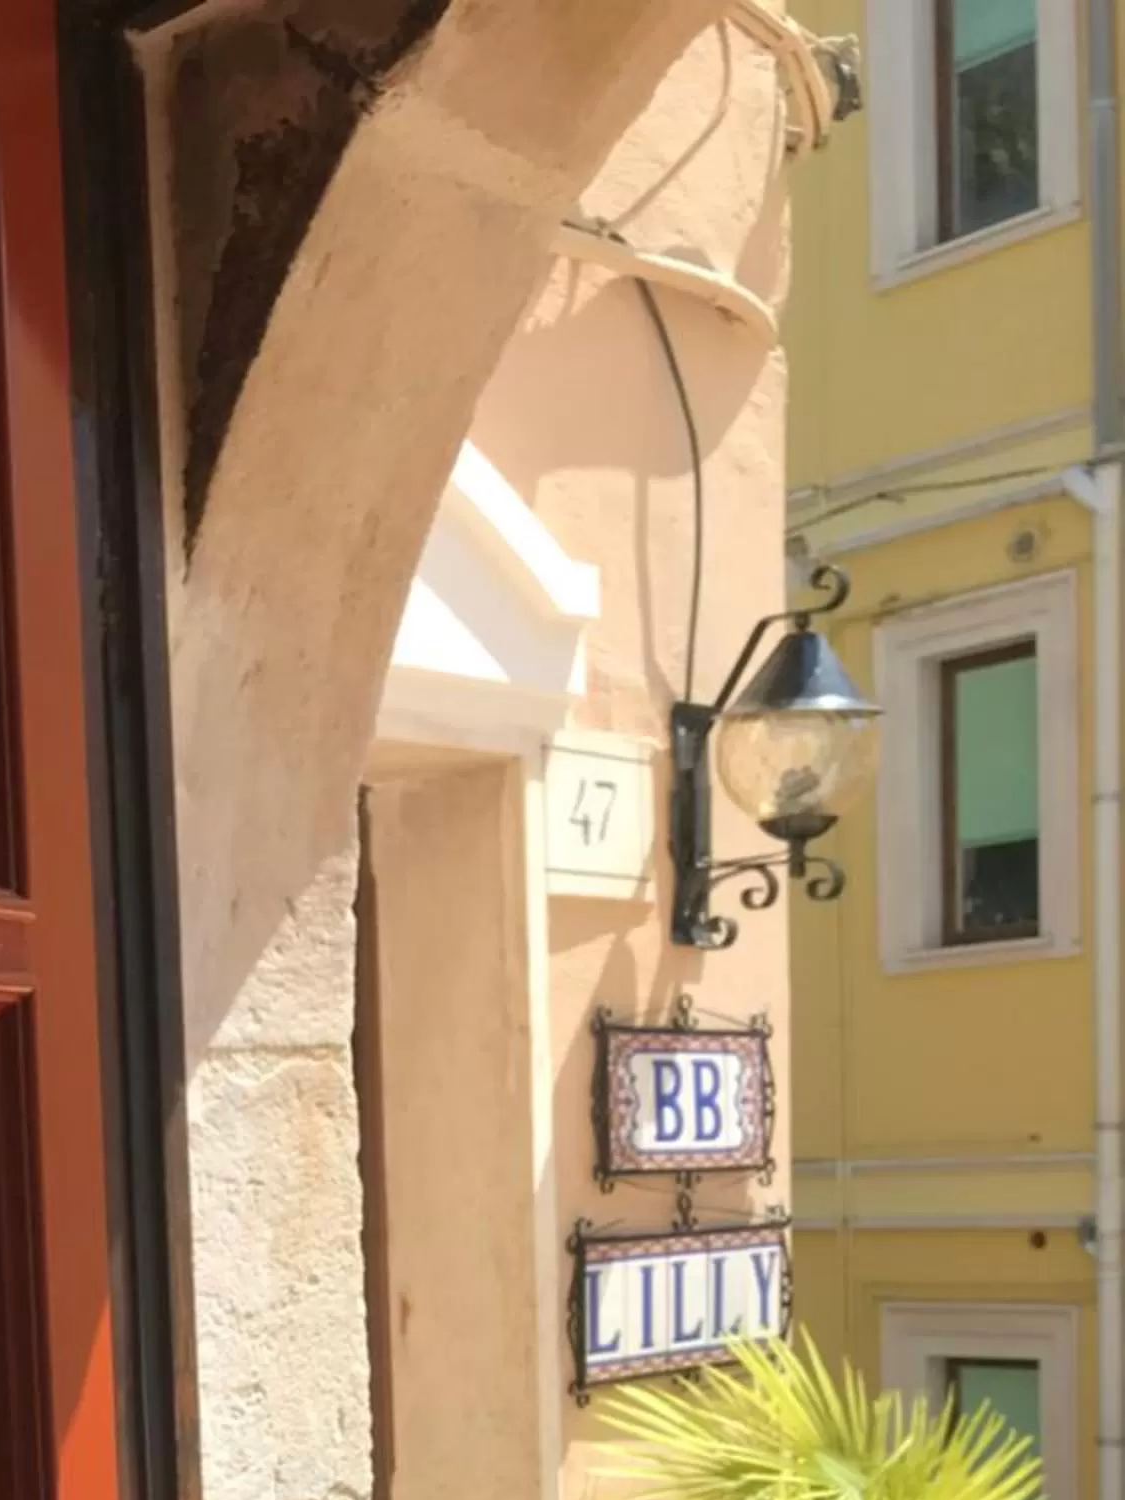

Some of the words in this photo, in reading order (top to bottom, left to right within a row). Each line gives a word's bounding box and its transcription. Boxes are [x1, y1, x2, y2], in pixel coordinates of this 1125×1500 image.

[568, 778, 617, 847] 47
[653, 1059, 722, 1142] BB
[586, 1252, 777, 1355] LILLY
